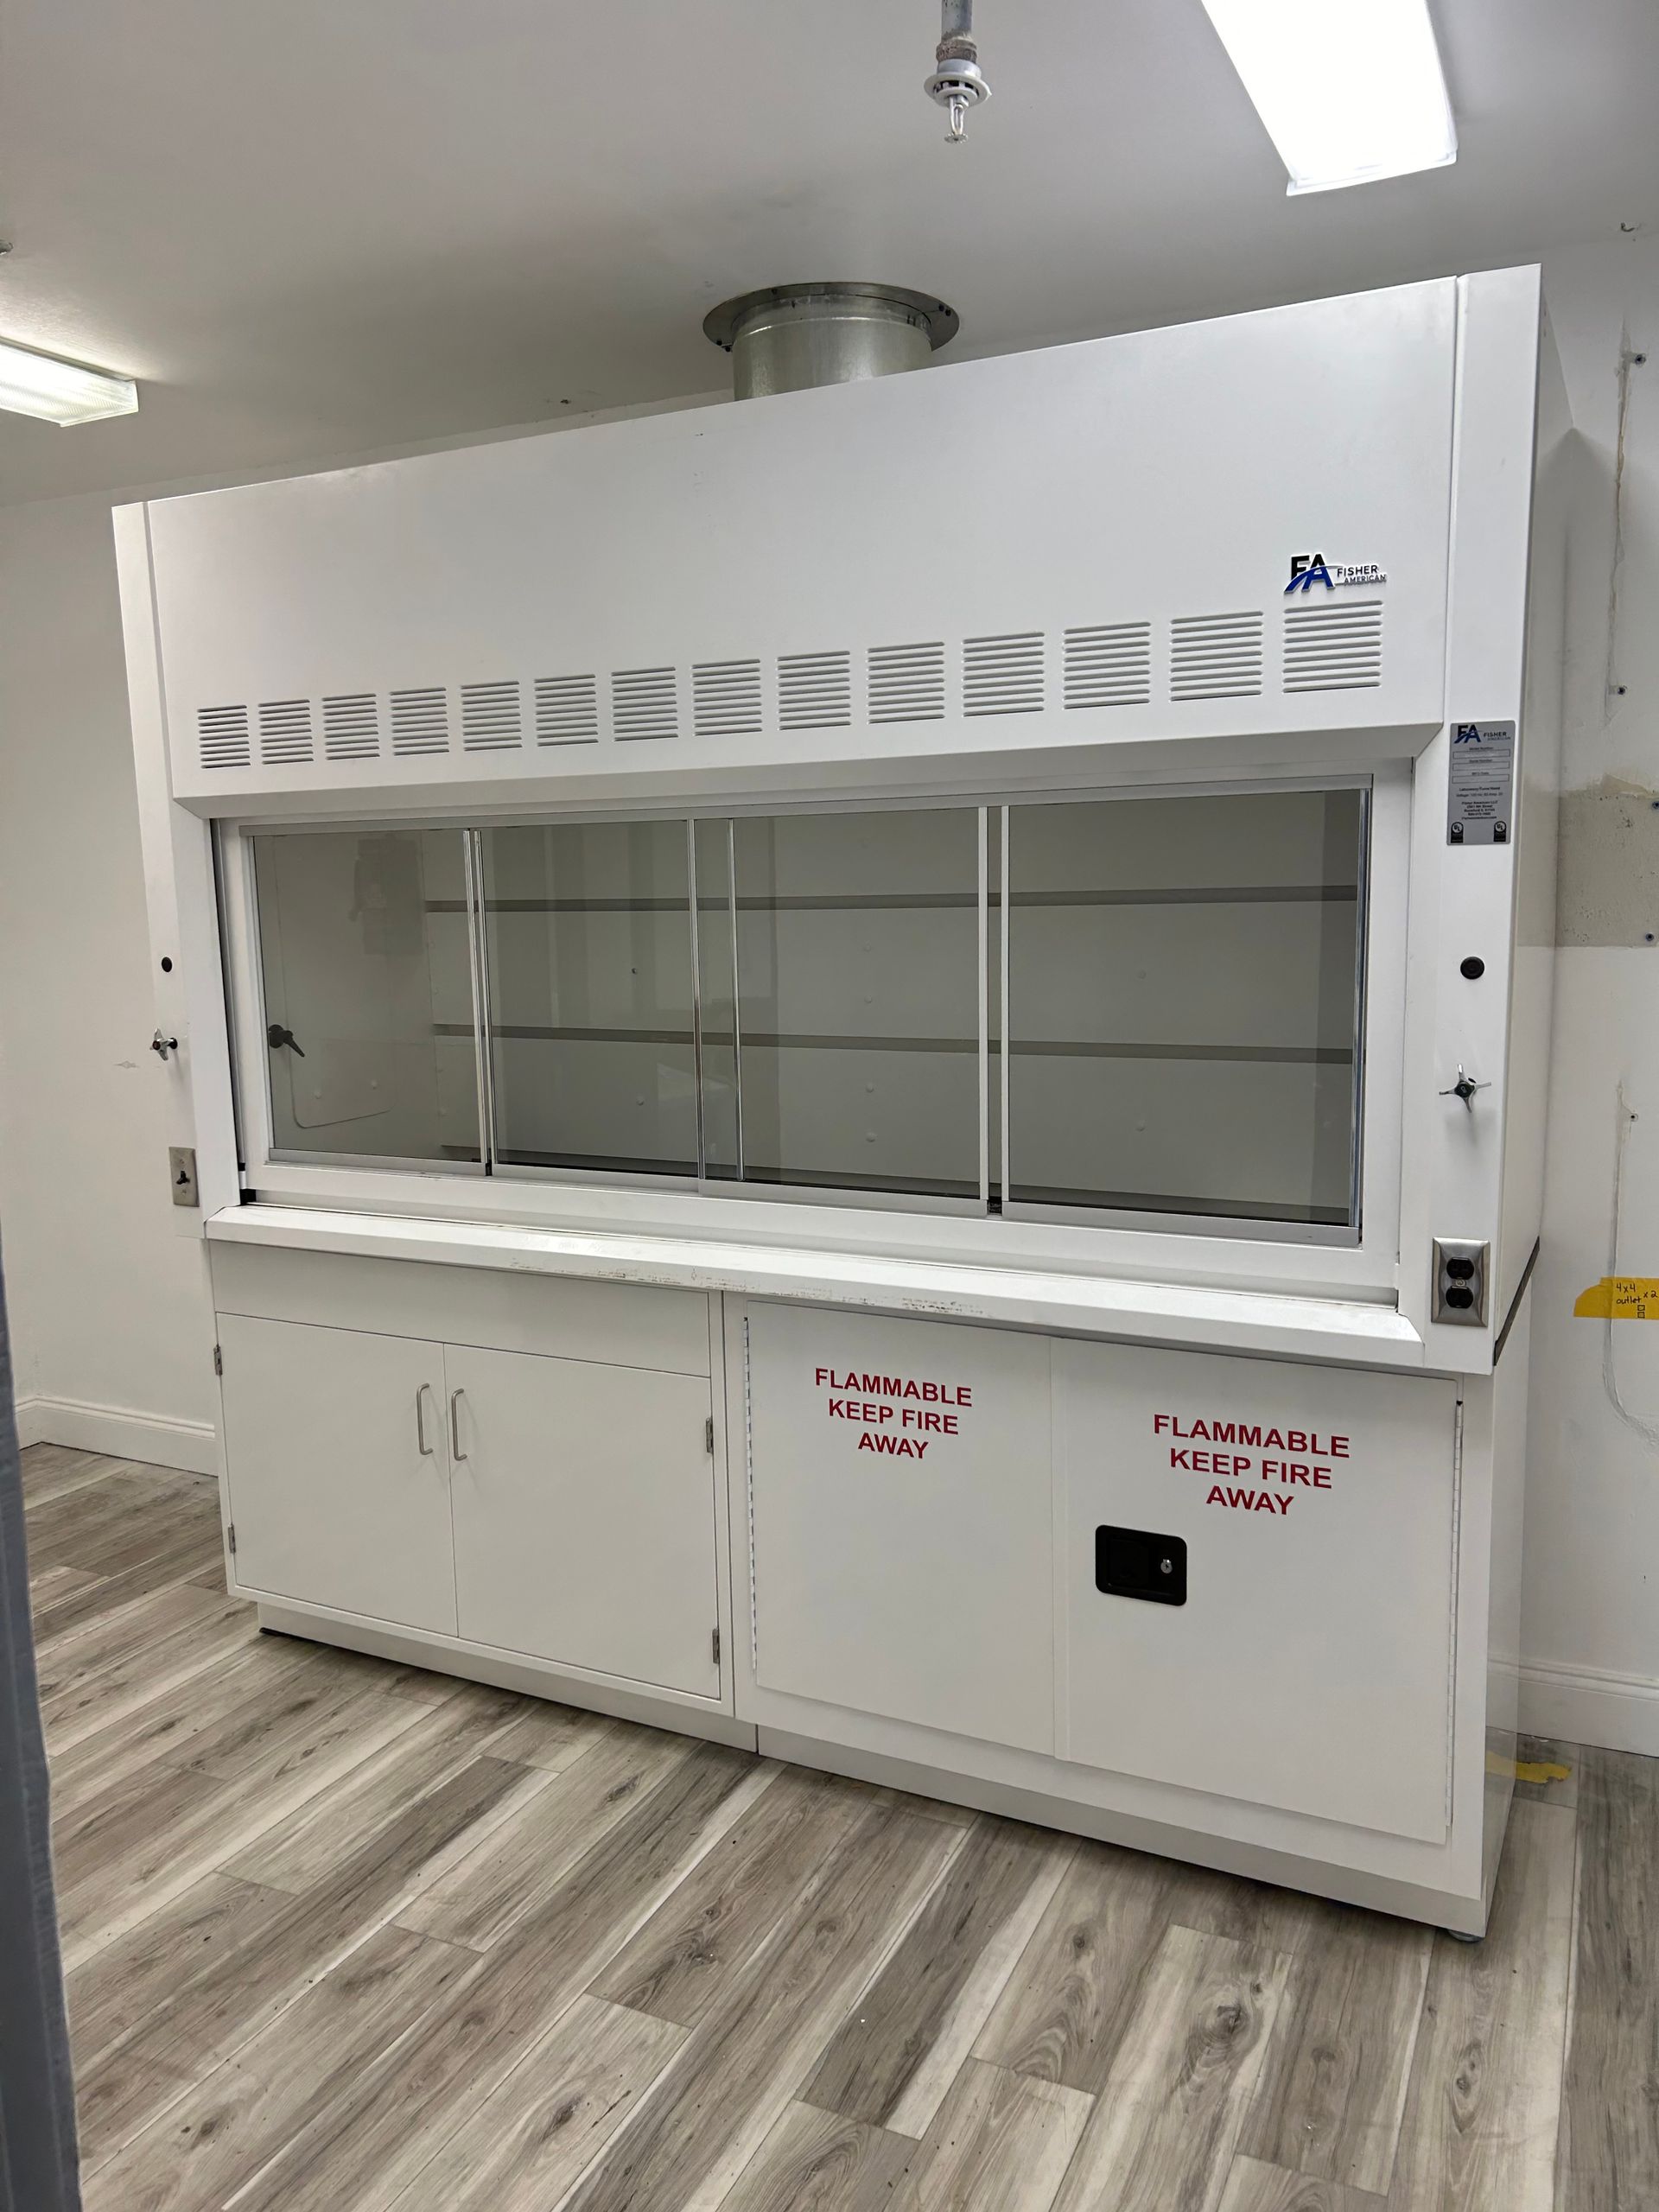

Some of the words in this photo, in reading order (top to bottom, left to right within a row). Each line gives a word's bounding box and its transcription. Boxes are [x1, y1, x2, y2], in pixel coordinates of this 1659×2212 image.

[1284, 553, 1335, 593] FA
[1337, 564, 1378, 578] FISHER
[1344, 574, 1387, 585] AMERICAN
[1616, 1296, 1642, 1305] outlet
[815, 1367, 972, 1407] FLAMMABLE
[829, 1398, 893, 1424] KEEP
[902, 1408, 958, 1435] FIRE
[858, 1432, 929, 1459] AWAY
[1154, 1414, 1350, 1459] FLAMMABLE
[1170, 1447, 1251, 1476] KEEP
[1262, 1459, 1332, 1489] FIRE
[1205, 1485, 1294, 1516] AWAY
